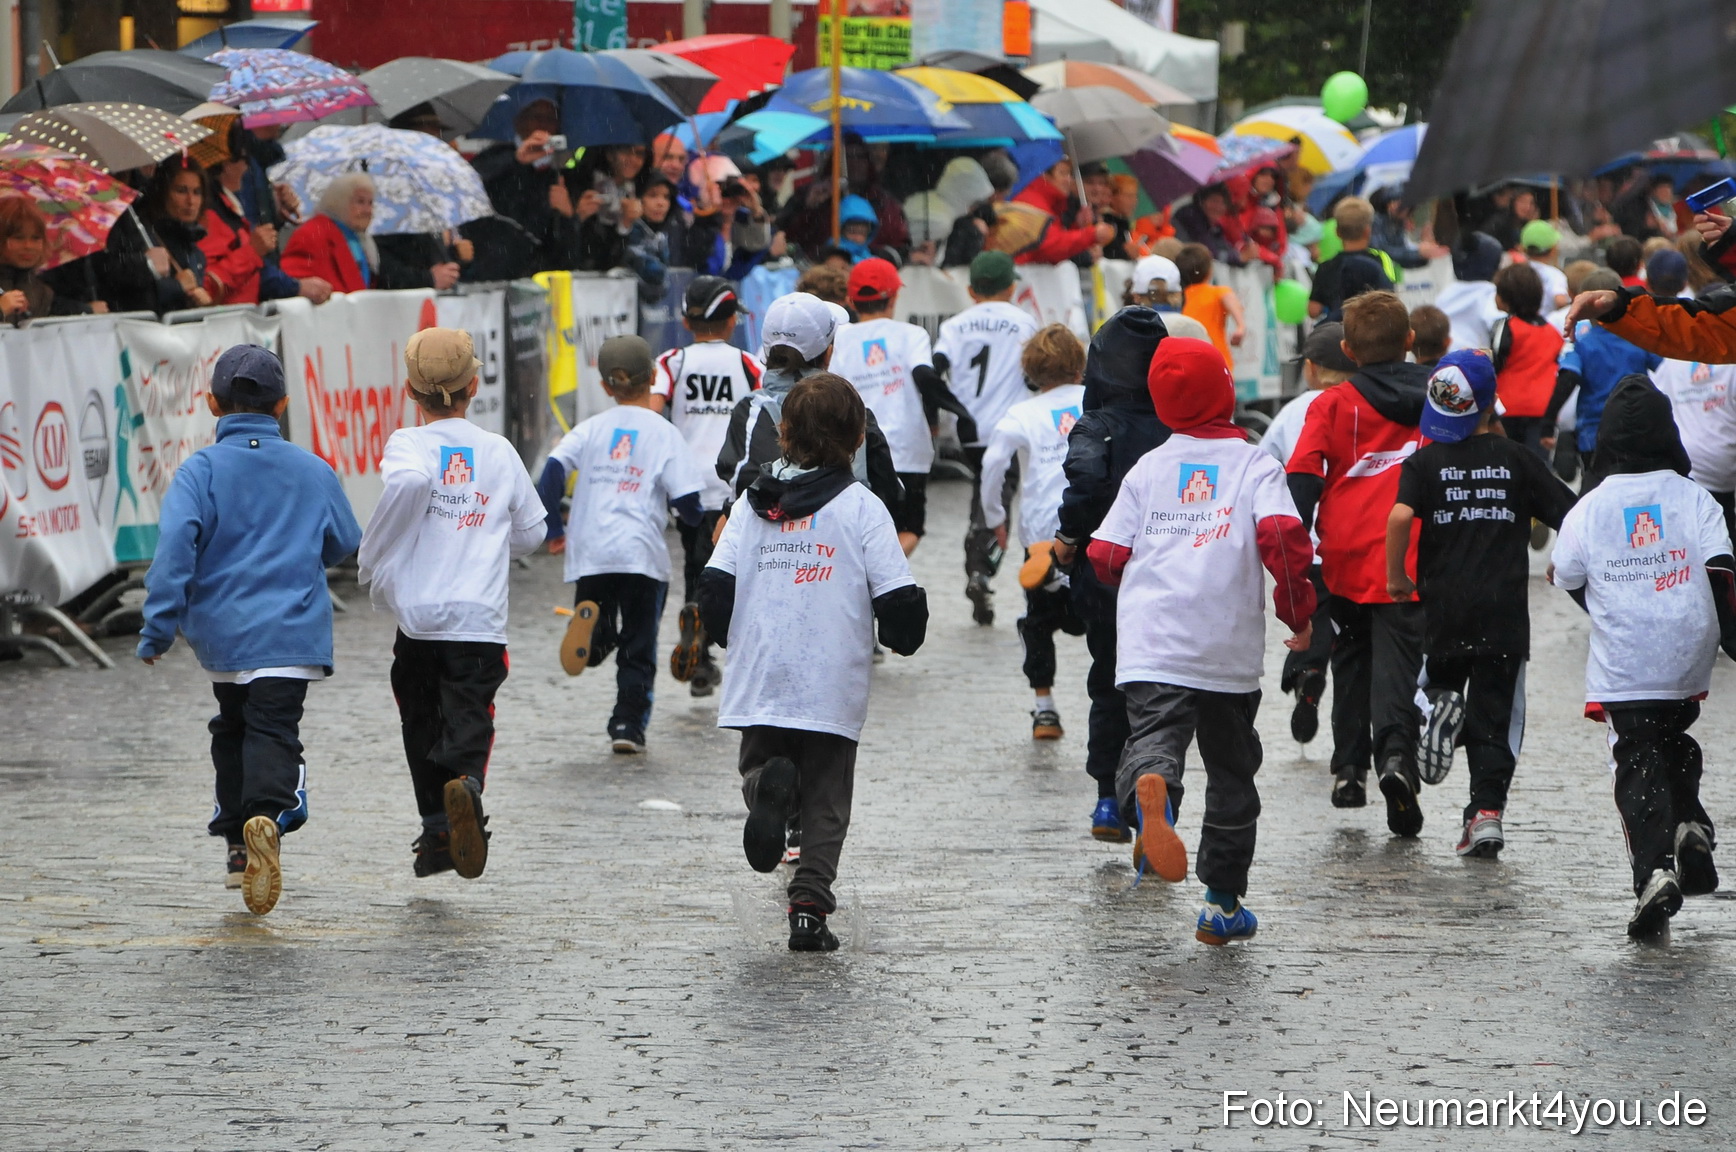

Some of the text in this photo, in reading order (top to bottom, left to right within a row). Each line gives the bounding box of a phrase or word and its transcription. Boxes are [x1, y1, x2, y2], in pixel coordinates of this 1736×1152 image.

[970, 344, 991, 398] 1
[686, 374, 734, 401] SVA
[1440, 465, 1511, 481] für mich
[475, 492, 490, 506] TV
[1446, 487, 1507, 502] für uns
[1151, 507, 1233, 522] neumarkt TV
[1193, 522, 1231, 548] 2011
[760, 541, 836, 558] neumarkt TV
[1606, 548, 1686, 568] neumarkt TV
[794, 566, 832, 584] 2011
[1655, 565, 1690, 592] 2011
